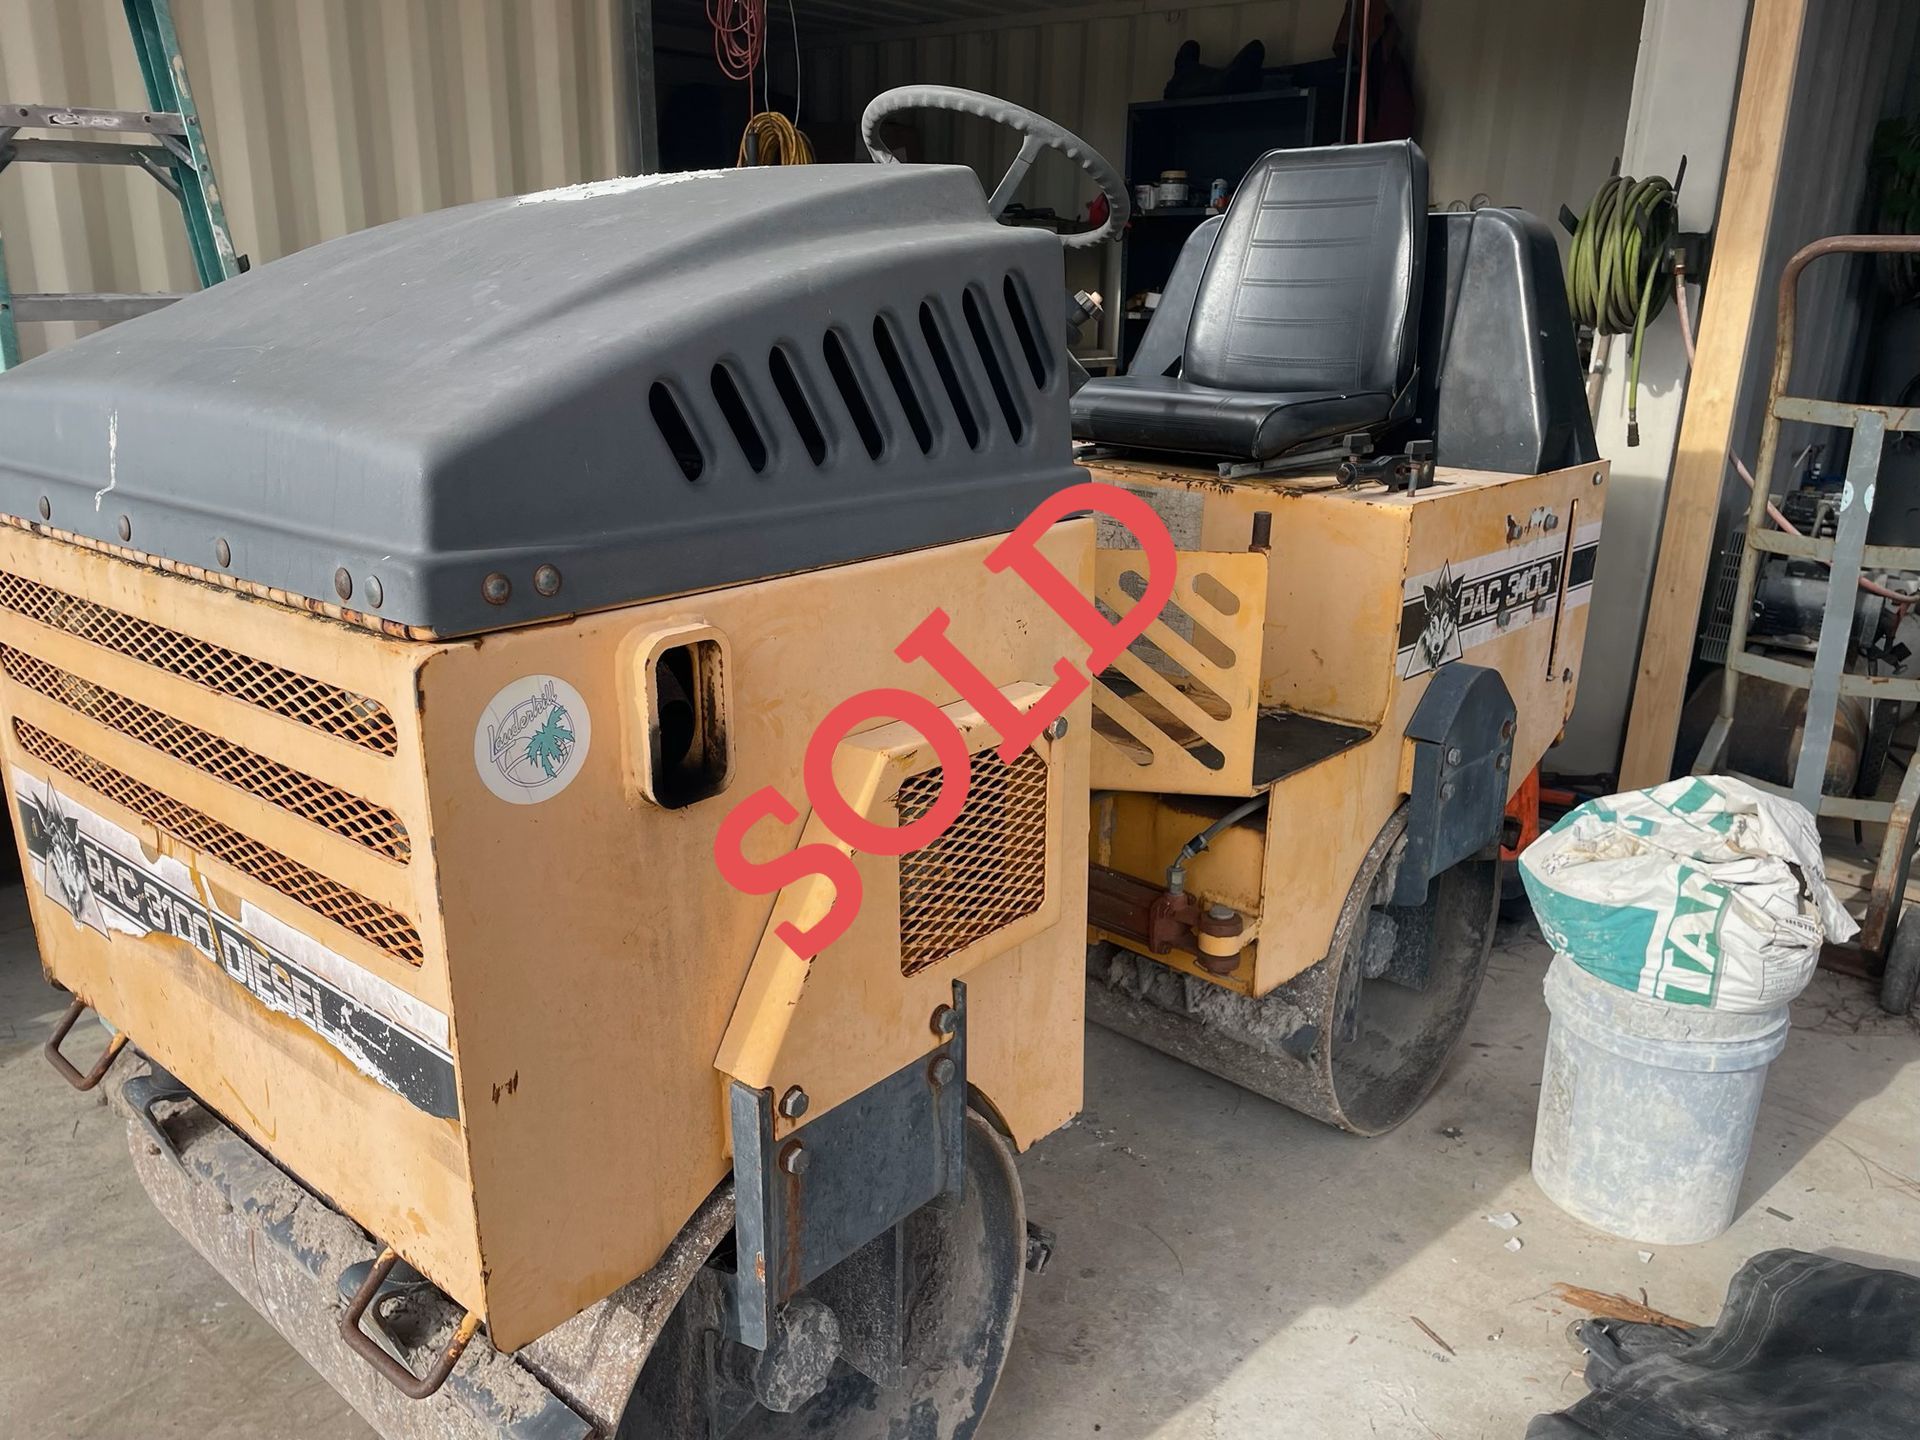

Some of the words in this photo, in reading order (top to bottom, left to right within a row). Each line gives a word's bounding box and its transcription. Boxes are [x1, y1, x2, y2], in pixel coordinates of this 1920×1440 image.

[1459, 579, 1502, 624] PAC
[84, 844, 140, 914] PAC
[143, 881, 217, 962] 3100
[220, 929, 338, 1046] DIESEL
